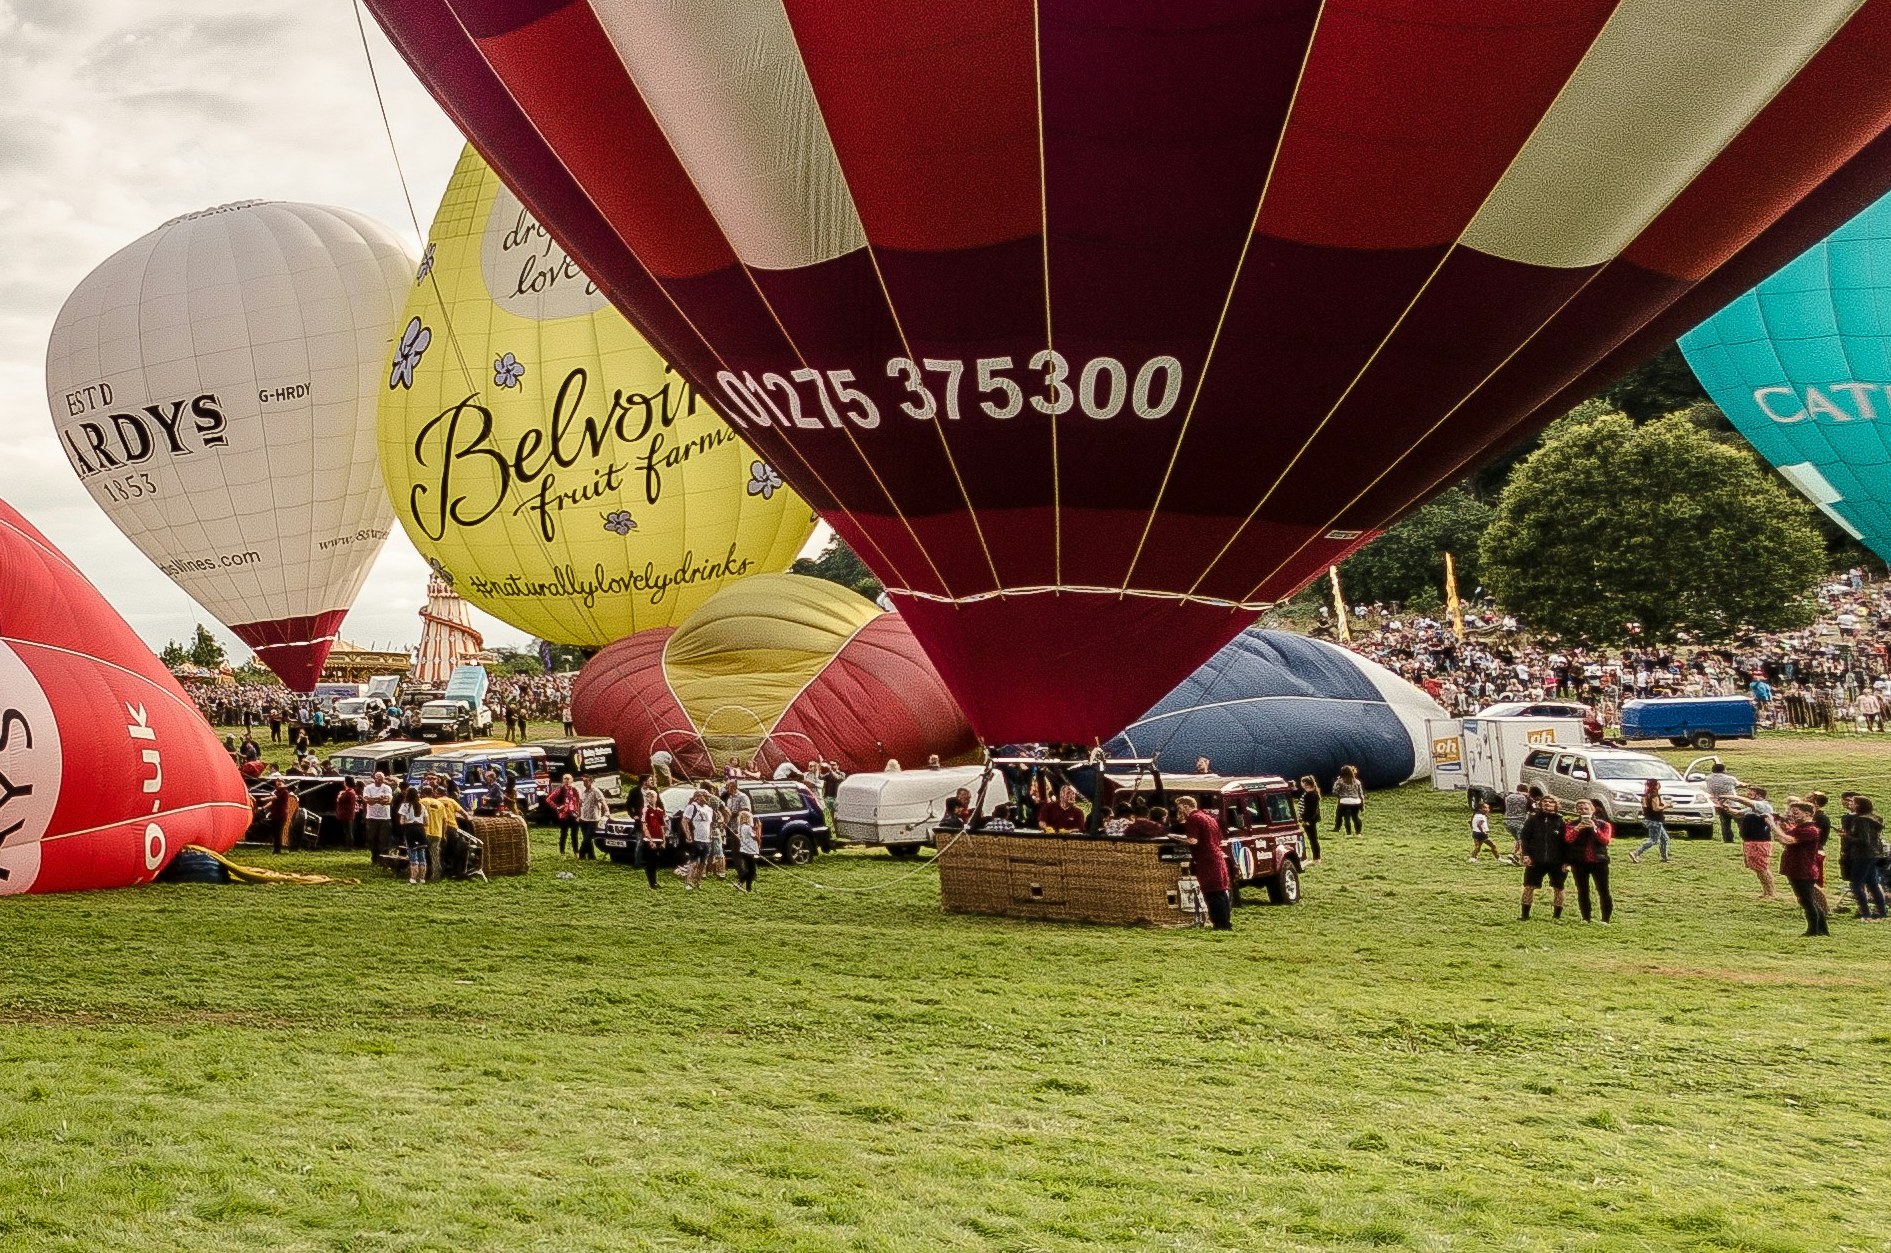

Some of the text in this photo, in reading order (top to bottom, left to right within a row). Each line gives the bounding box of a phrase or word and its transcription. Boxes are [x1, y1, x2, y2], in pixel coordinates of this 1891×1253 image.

[258, 382, 312, 404] G-HRDY
[716, 348, 1183, 430] 01275 375300
[102, 473, 157, 503] 1853
[513, 428, 742, 543] fruit farms
